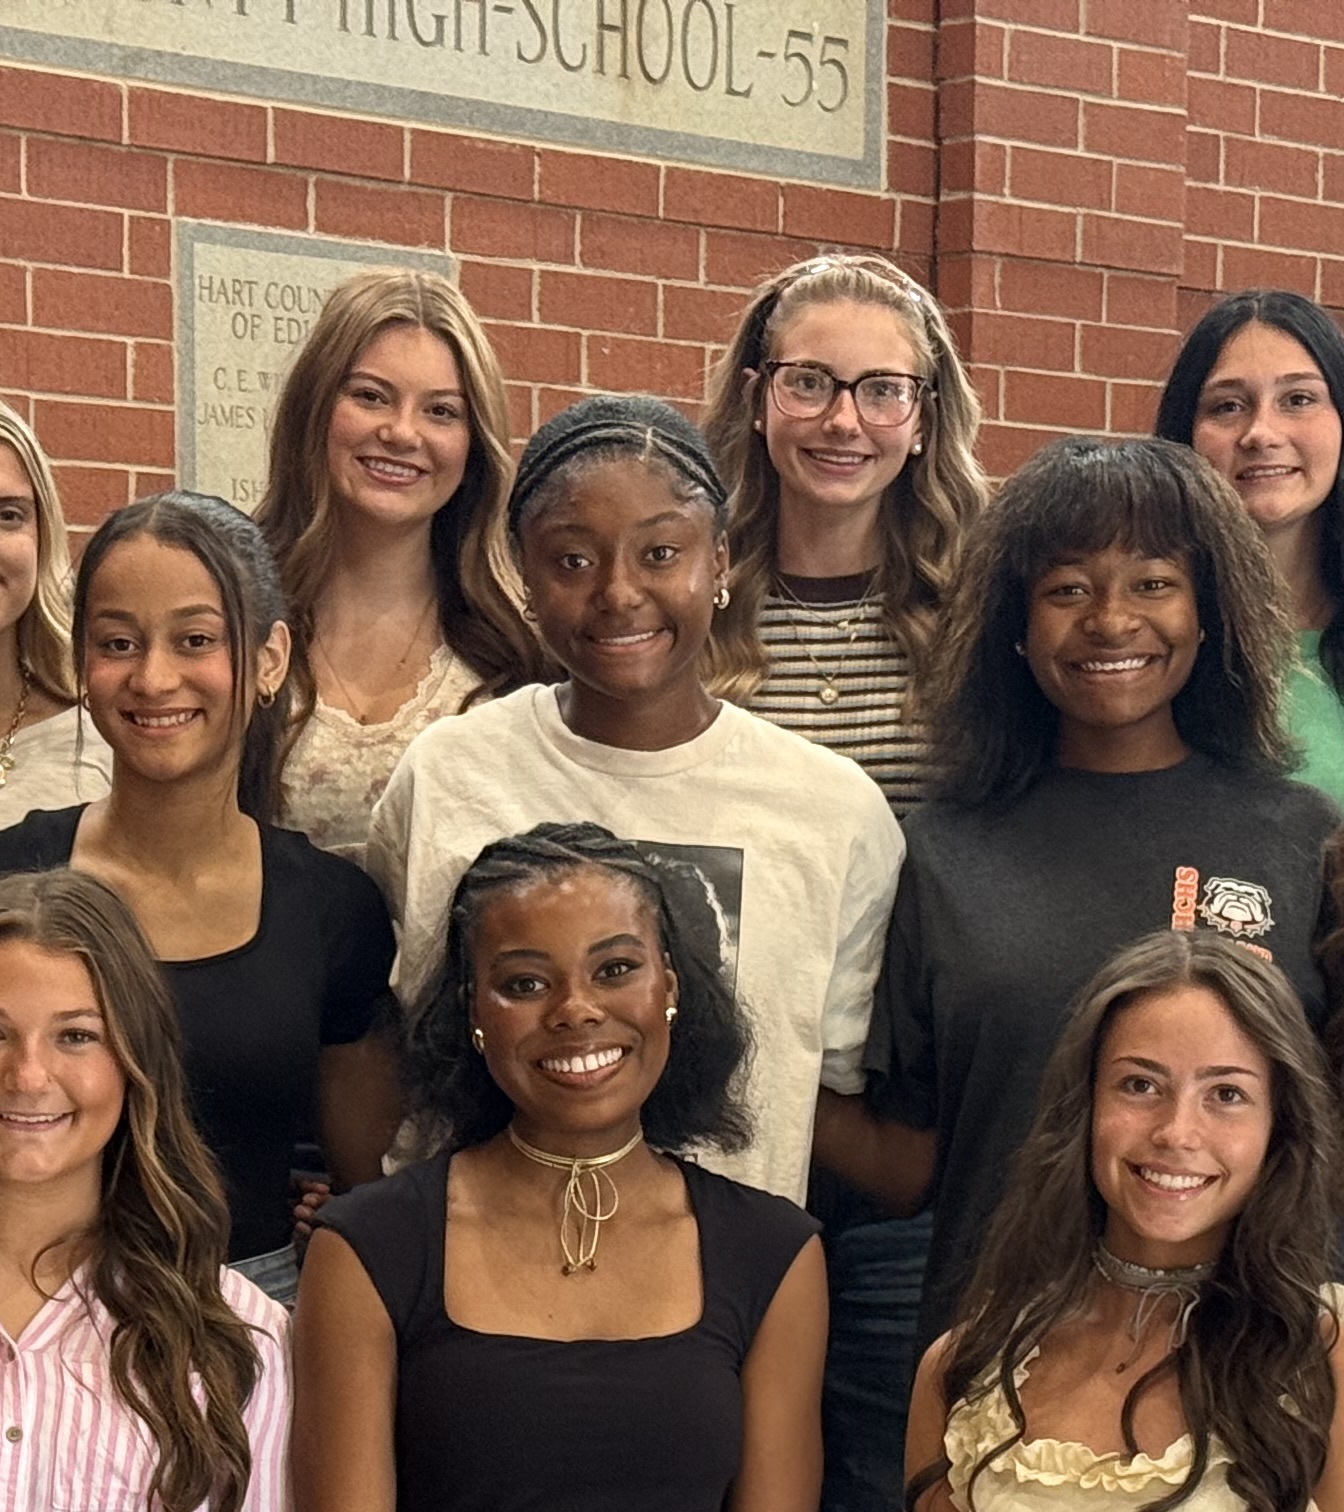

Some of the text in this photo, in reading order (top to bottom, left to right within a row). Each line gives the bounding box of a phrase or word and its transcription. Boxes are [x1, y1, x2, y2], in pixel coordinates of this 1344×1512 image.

[197, 274, 336, 314] HART COUN
[231, 311, 262, 341] OF
[196, 402, 256, 429] JAMES
[1172, 866, 1199, 931] HCHS
